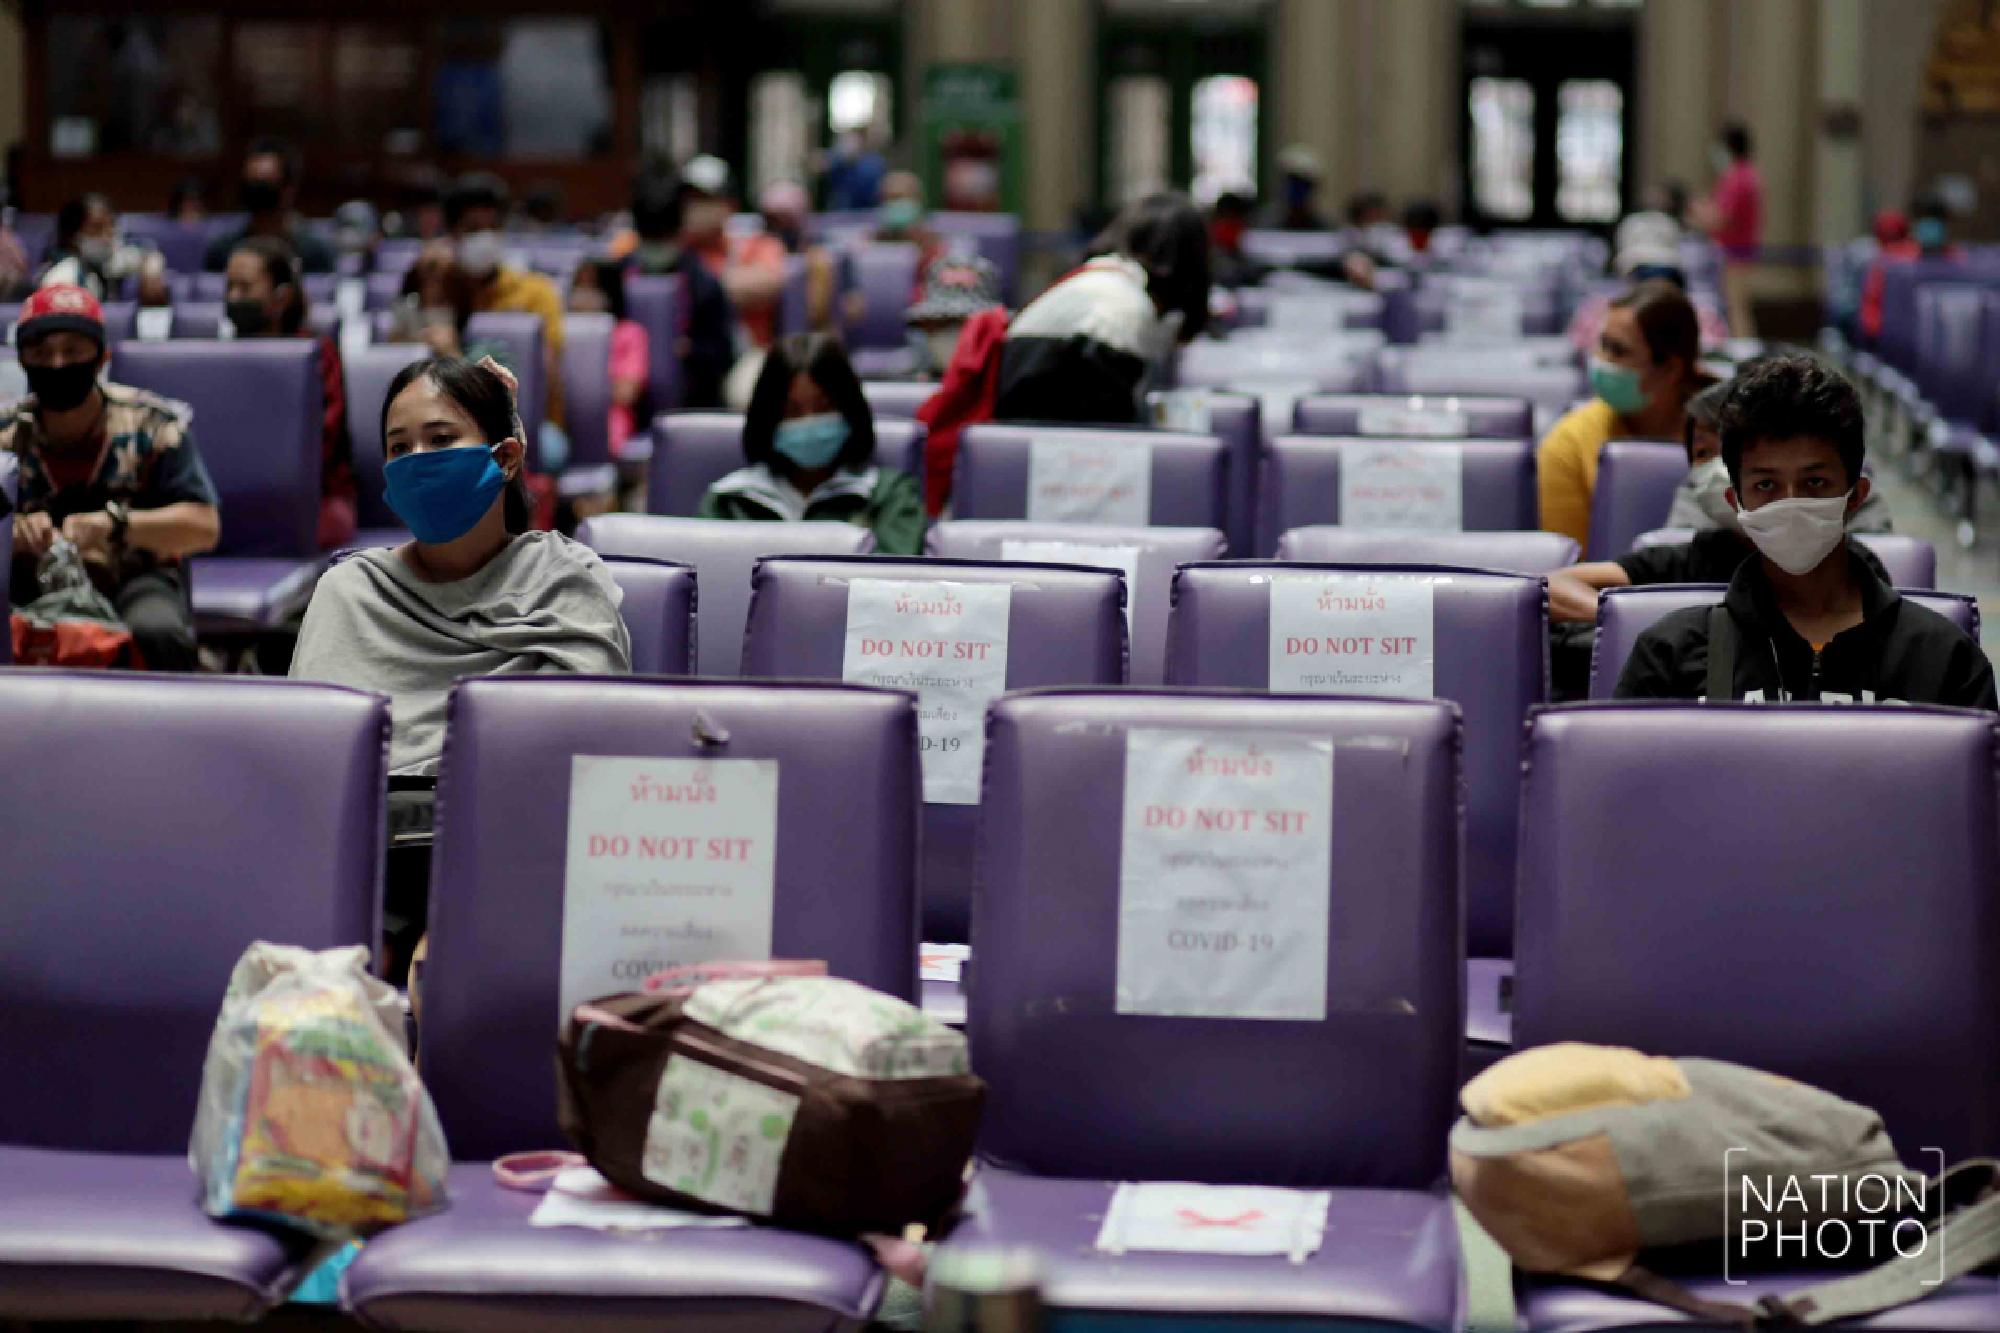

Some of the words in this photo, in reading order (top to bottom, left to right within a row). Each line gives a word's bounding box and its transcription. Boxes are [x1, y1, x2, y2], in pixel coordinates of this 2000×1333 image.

[895, 592, 963, 616] ห้ามนั่ง
[1317, 586, 1386, 611] ห้ามนั่ง
[861, 637, 894, 657] DO
[901, 639, 948, 659] NOT
[953, 641, 991, 660] SIT
[1286, 637, 1318, 656] DO
[1326, 637, 1374, 656] NOT
[1380, 637, 1417, 656] SIT
[921, 735, 961, 752] D-19
[1146, 805, 1187, 829] DO
[1196, 807, 1255, 832] NOT
[1263, 810, 1310, 835] SIT
[587, 834, 630, 858] DO
[637, 836, 699, 861] NOT
[705, 838, 753, 862] SIT
[1167, 929, 1274, 952] COVID-19
